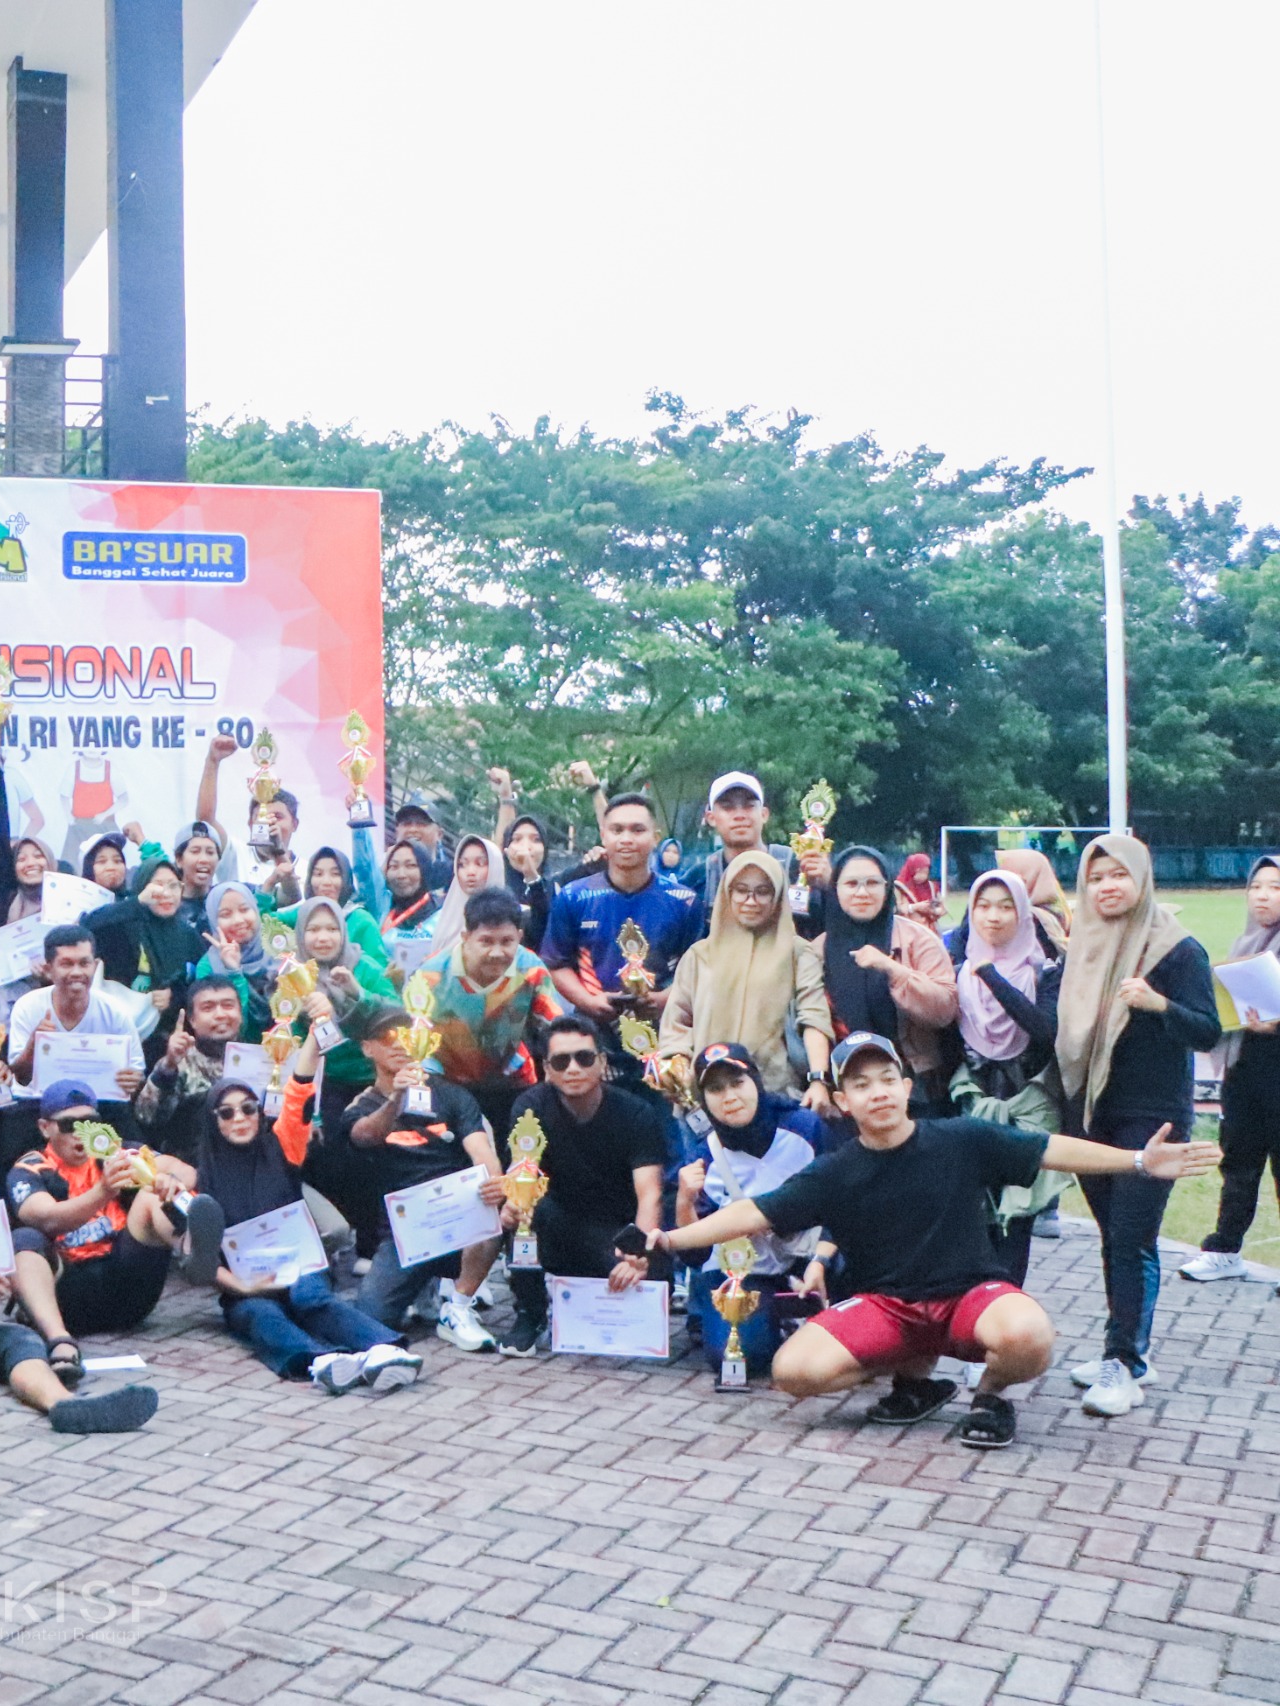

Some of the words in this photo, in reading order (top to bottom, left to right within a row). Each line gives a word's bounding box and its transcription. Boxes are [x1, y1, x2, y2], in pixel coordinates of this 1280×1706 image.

[71, 565, 137, 579] Banggai
[141, 566, 187, 578] Sehat
[191, 568, 234, 579] Juara
[68, 715, 141, 748] YANG
[152, 715, 185, 748] KE
